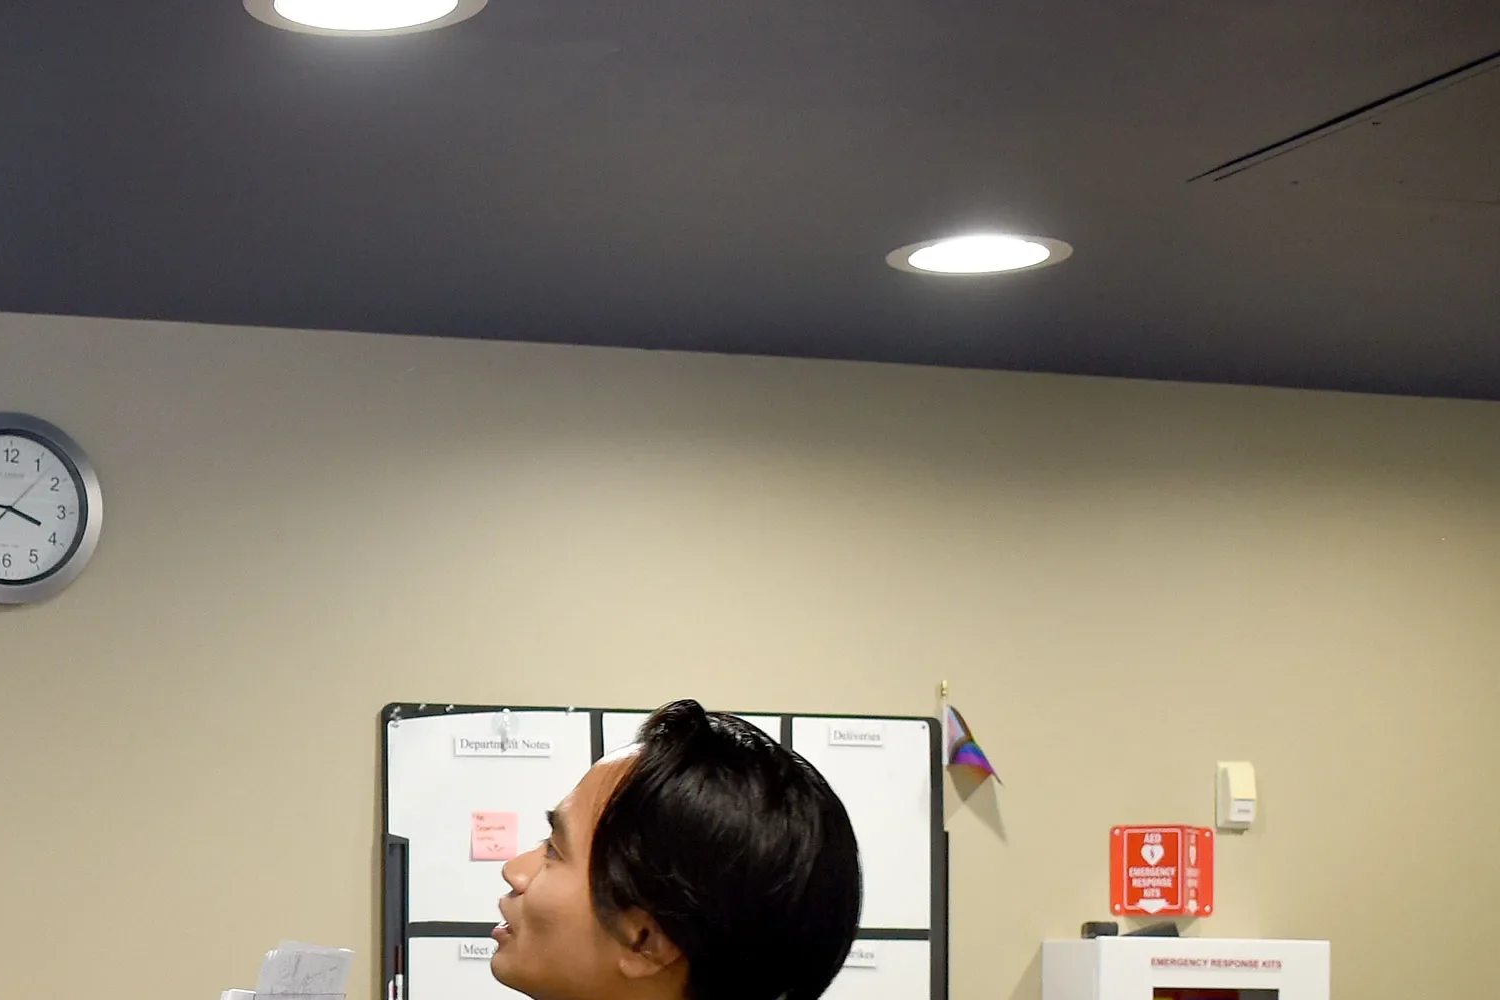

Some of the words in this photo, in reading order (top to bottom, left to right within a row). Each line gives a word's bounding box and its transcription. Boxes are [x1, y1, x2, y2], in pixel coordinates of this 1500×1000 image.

[4, 448, 20, 464] 12
[34, 458, 41, 472] 1
[50, 477, 60, 492] 2
[56, 505, 66, 520] 3
[47, 532, 57, 545] 4
[1, 553, 12, 568] 6
[28, 549, 38, 564] 5
[521, 739, 550, 750] Notes
[463, 944, 489, 955] Meet
[1151, 957, 1208, 967] EMERGENCY
[1211, 959, 1259, 969] RESPONSE
[1262, 960, 1282, 969] KITS
